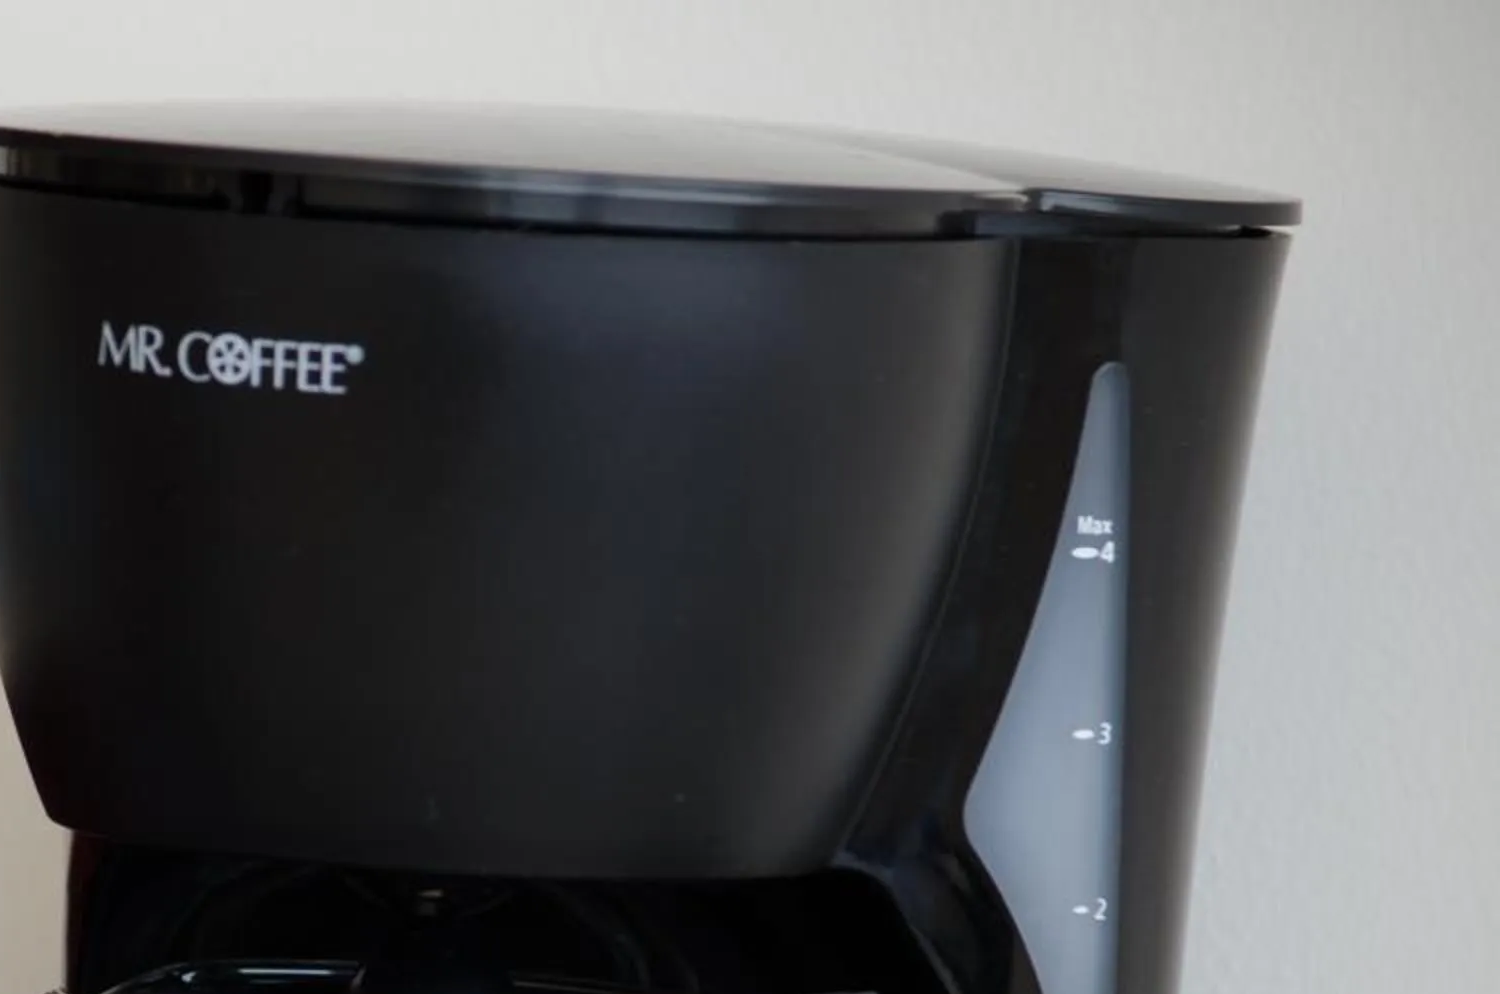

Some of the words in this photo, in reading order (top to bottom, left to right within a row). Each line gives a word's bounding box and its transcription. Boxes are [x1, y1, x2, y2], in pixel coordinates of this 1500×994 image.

[177, 331, 348, 395] COFFEE
[1077, 515, 1113, 536] Max
[1100, 541, 1115, 564] 4
[1097, 723, 1113, 745] 3
[1093, 898, 1108, 921] 2
